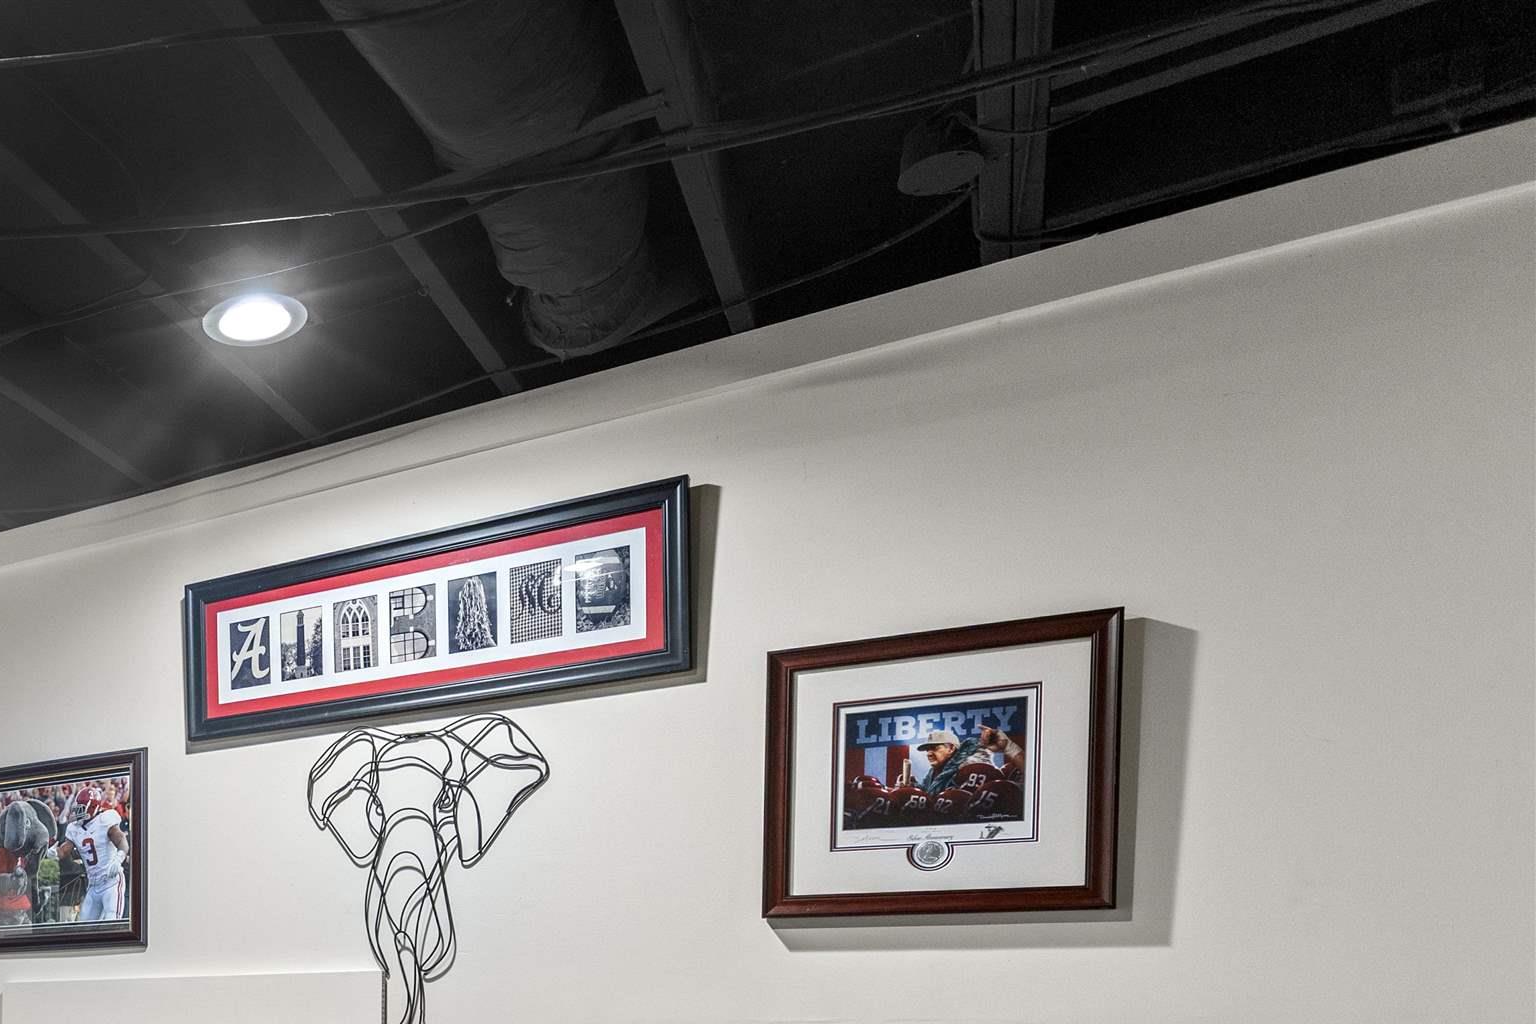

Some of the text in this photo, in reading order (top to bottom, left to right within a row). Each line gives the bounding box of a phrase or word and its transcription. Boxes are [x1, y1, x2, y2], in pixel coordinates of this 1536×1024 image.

[856, 705, 1017, 744] LIBERTY
[967, 772, 986, 788] 93
[909, 794, 927, 809] 58
[81, 838, 98, 866] 3
